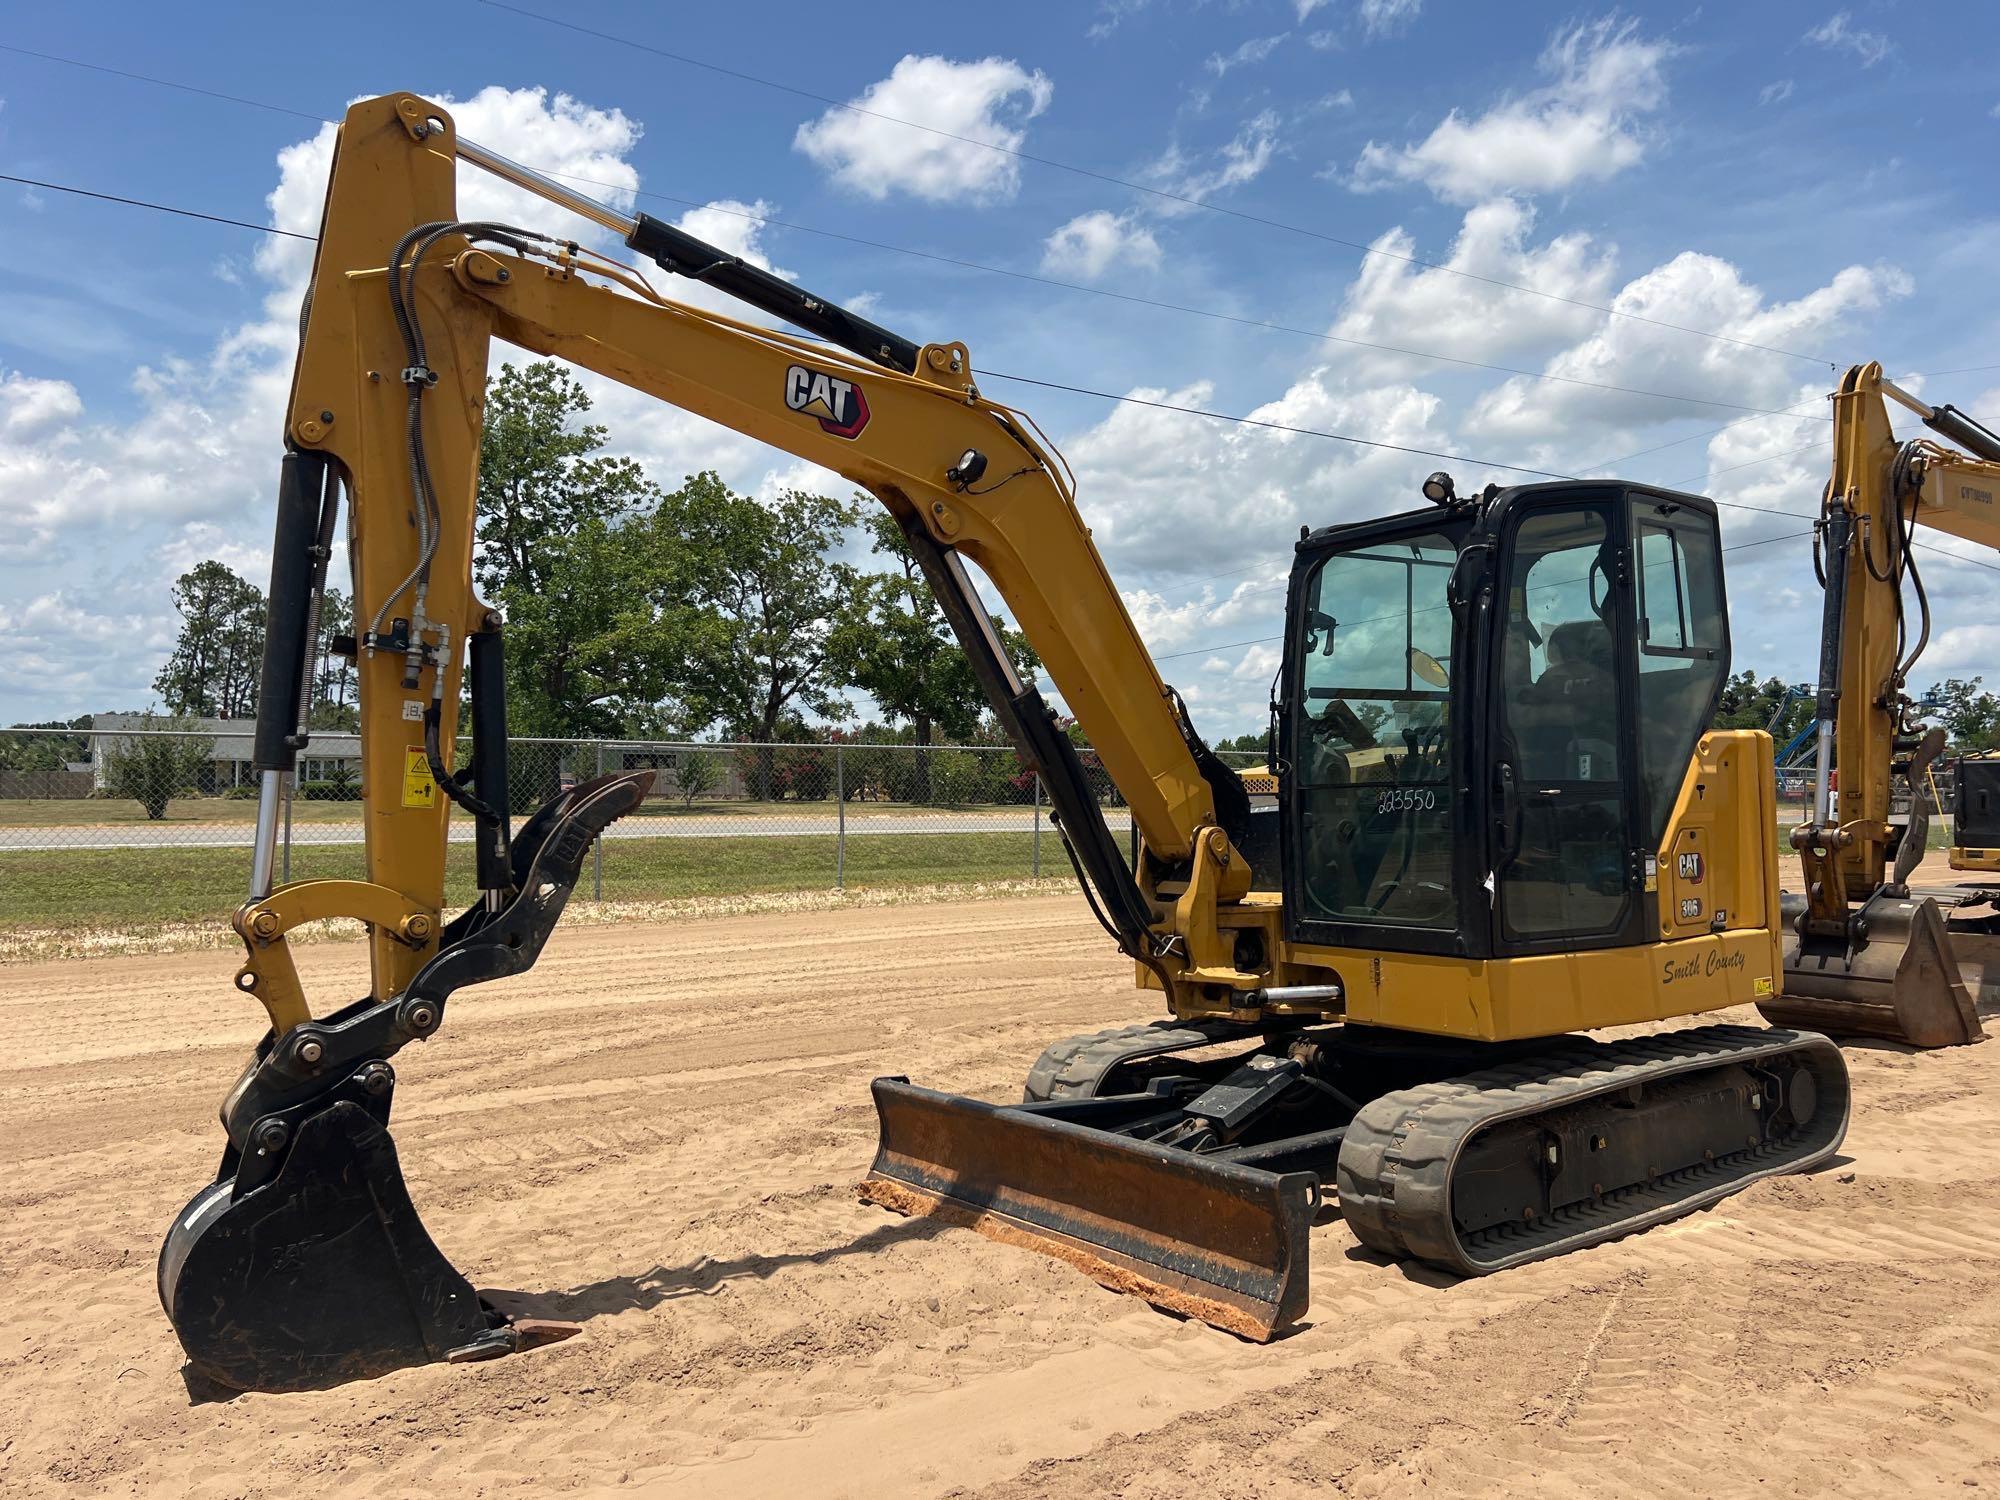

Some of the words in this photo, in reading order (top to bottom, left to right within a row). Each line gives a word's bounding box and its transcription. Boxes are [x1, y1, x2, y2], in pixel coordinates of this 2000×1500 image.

[786, 365, 852, 423] CAT
[1378, 789, 1435, 814] 223550
[1679, 853, 1699, 878] CAT
[1681, 899, 1699, 917] 306
[1663, 953, 1701, 984] Smith
[1705, 949, 1746, 977] County
